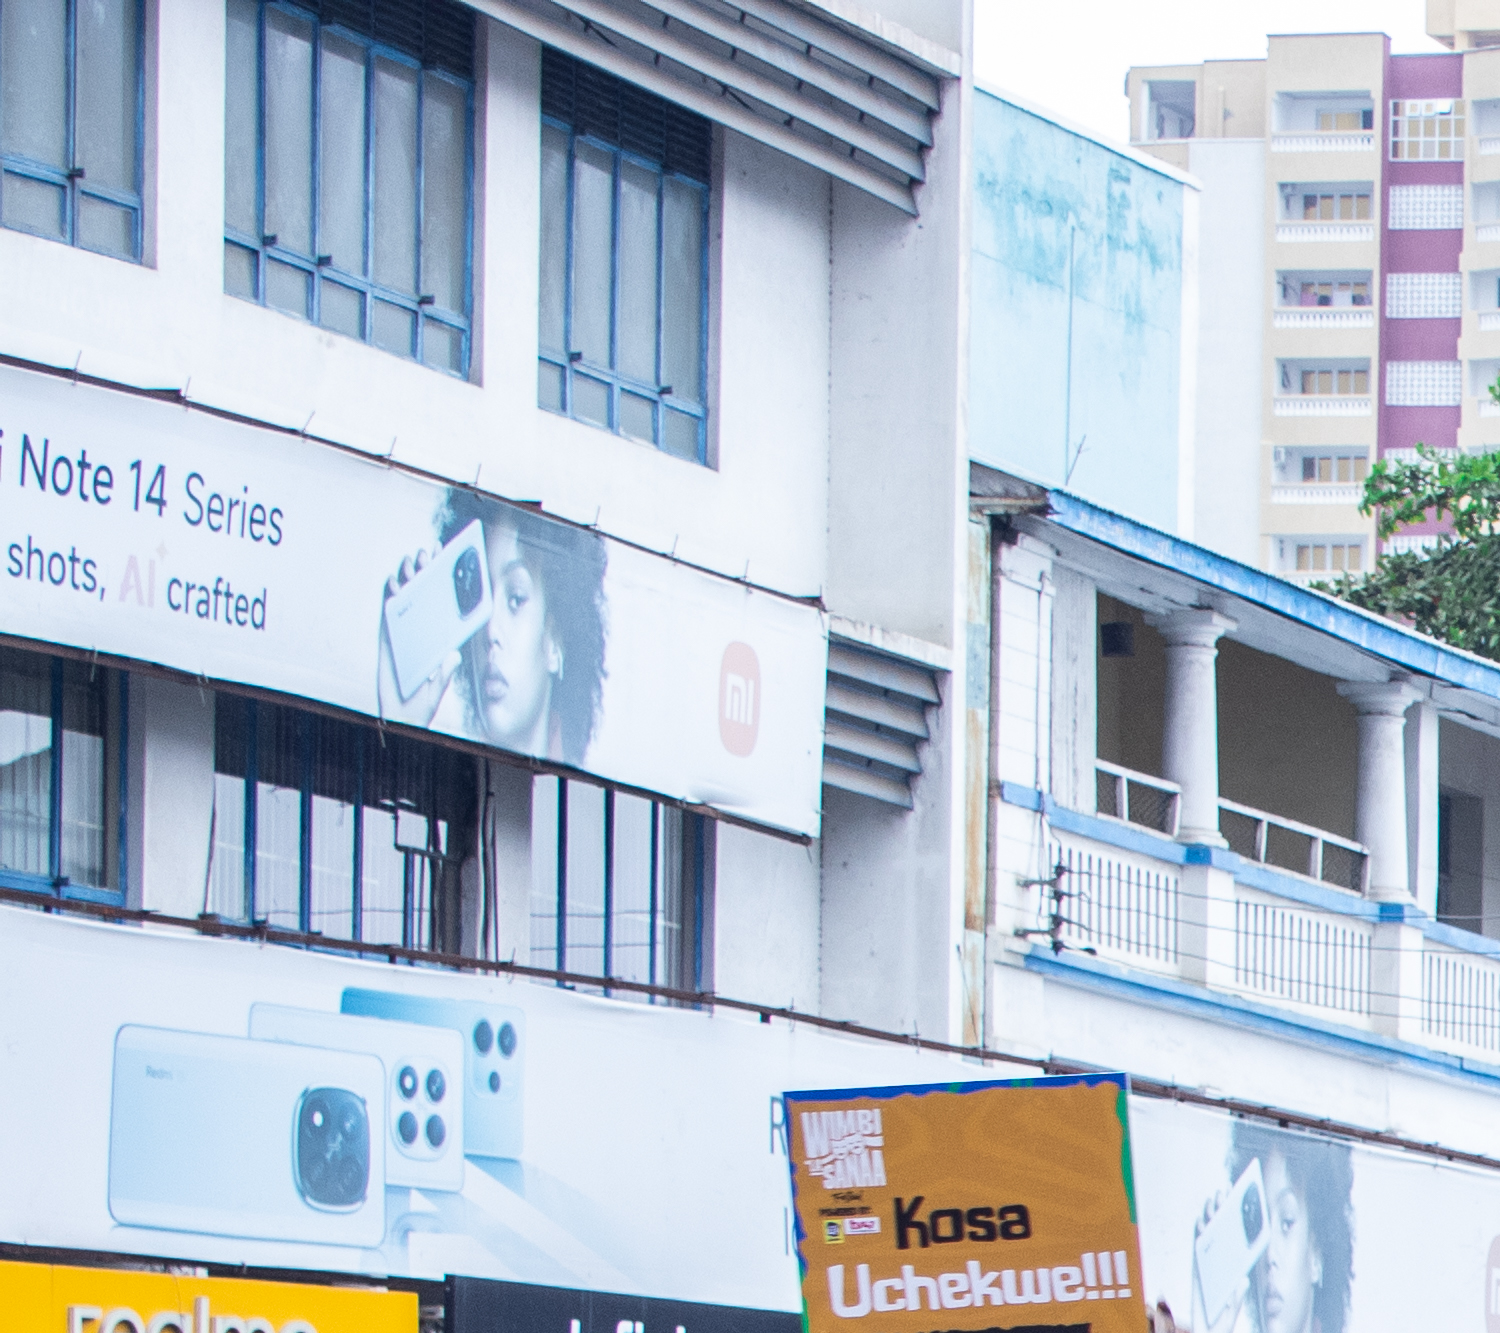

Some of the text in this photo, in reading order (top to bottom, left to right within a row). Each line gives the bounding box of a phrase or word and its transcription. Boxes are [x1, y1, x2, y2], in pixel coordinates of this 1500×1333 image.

[20, 433, 283, 546] Note 14 Series
[7, 534, 267, 631] shots, AI crafted
[893, 1196, 1031, 1250] Kosa
[828, 1251, 1132, 1319] Uchekwe!!!
